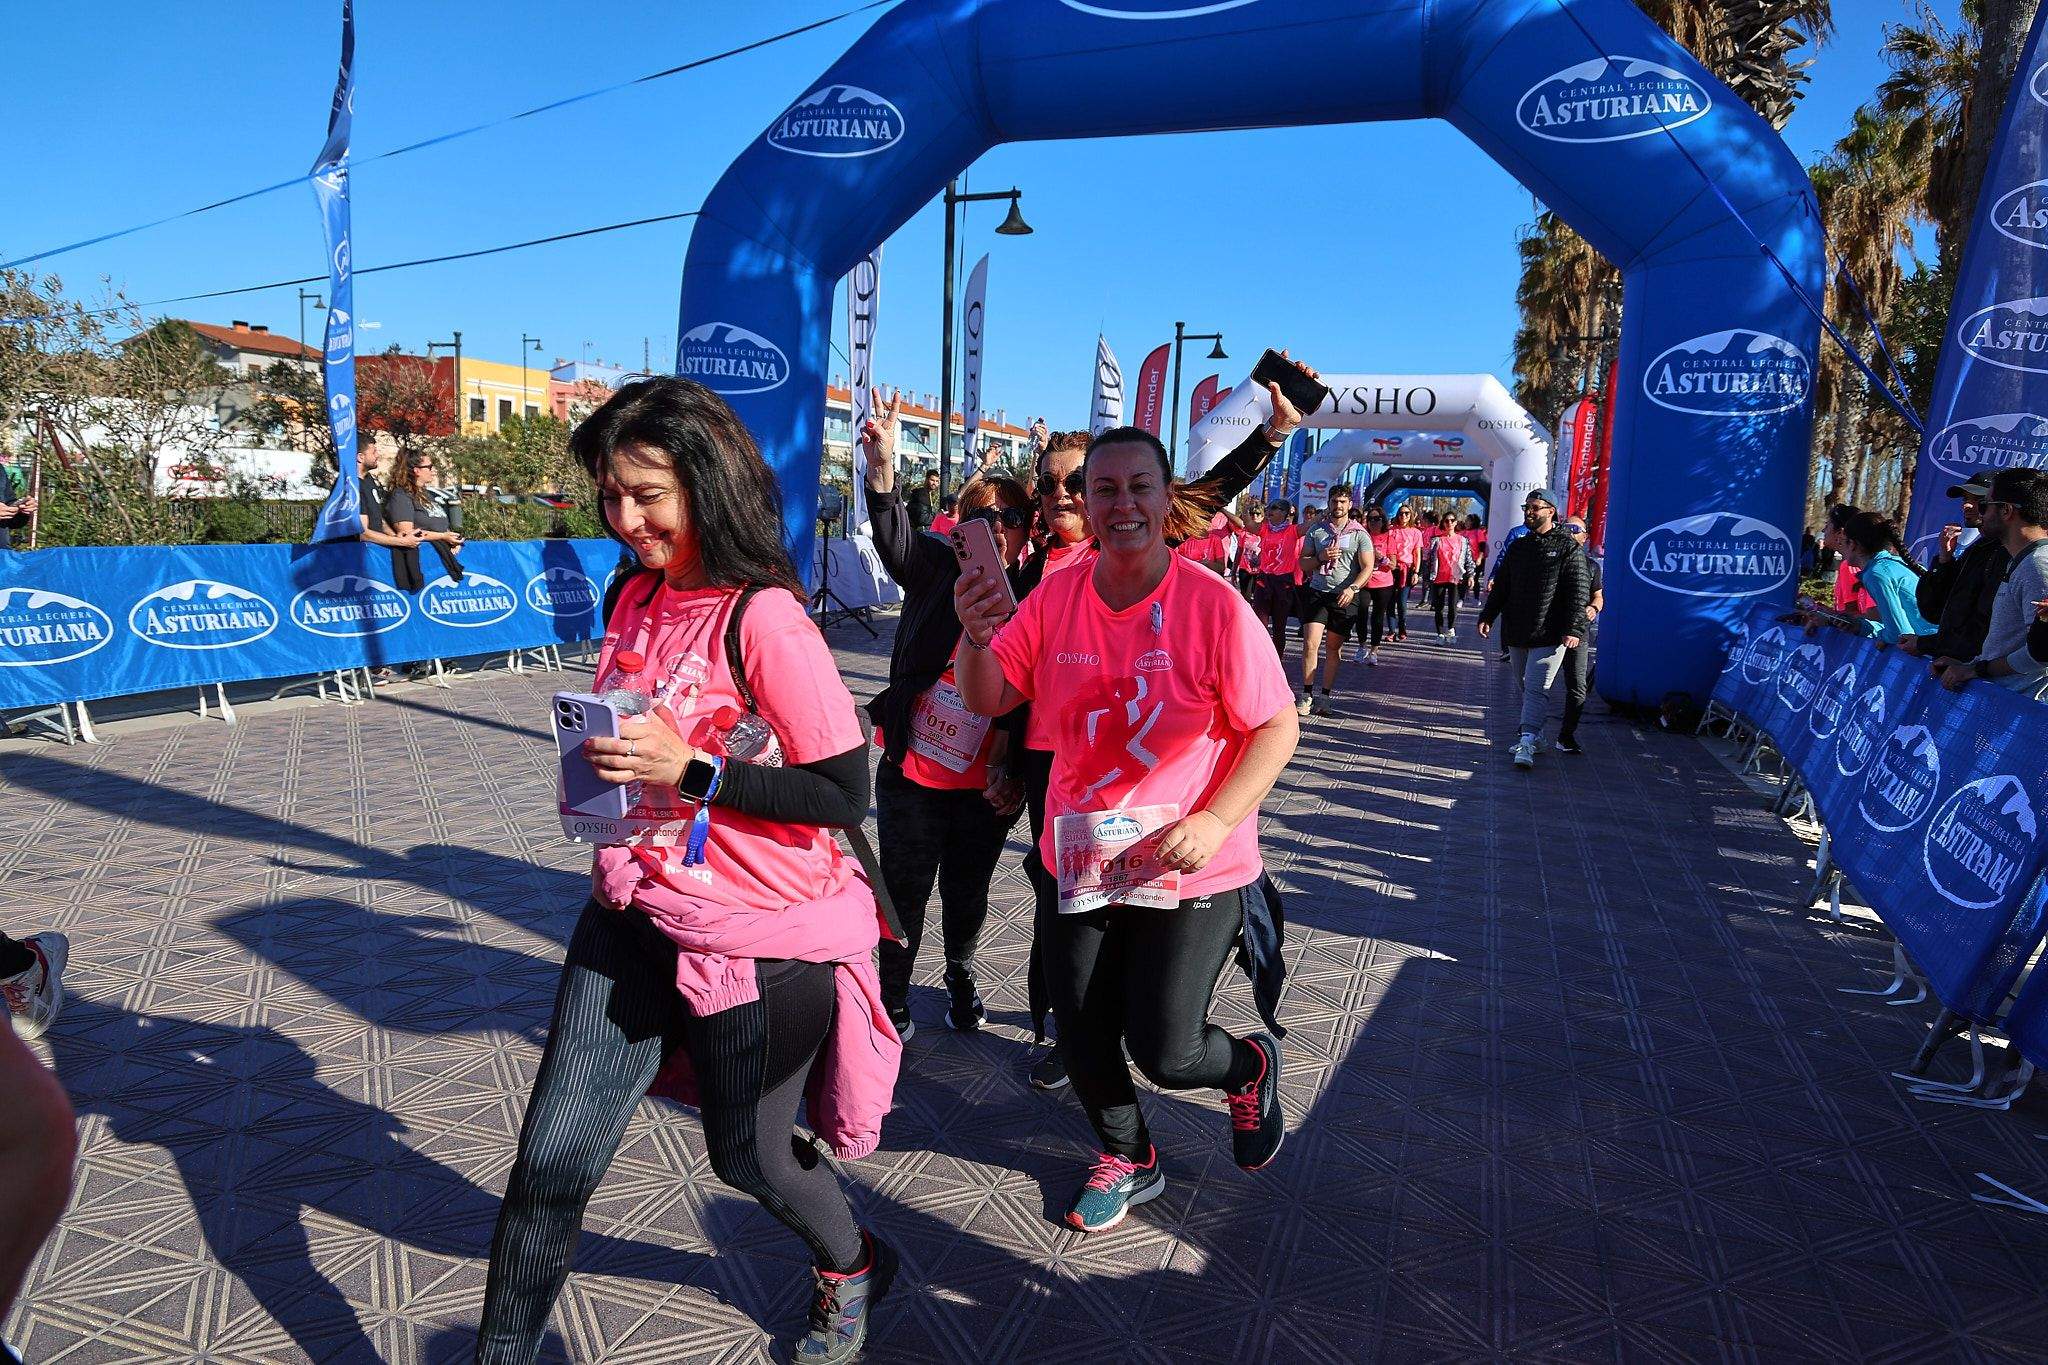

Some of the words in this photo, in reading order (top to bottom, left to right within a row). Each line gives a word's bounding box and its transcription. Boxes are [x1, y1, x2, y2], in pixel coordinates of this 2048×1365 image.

[1559, 83, 1623, 98] CENTRAL
[1630, 81, 1690, 93] LECHERA
[796, 108, 836, 118] CENTRAL
[840, 108, 888, 116] LECHERA
[1531, 93, 1699, 127] ASTURIANA
[773, 116, 893, 140] ASTURIANA
[1968, 318, 2048, 352] ASTU
[687, 346, 724, 354] CENTRAL
[727, 347, 775, 360] LECHERA
[677, 348, 779, 381] ASTURIANA
[1683, 359, 1744, 368] CENTRAL
[1653, 363, 1803, 395] ASTURIANA
[1144, 368, 1160, 432] ntander
[1328, 386, 1437, 416] YSHO
[1210, 415, 1251, 427] OYSHO
[1478, 420, 1524, 430] OYSHO
[1971, 434, 2026, 448] CENTRAL
[1403, 474, 1469, 483] VOLVO
[1668, 540, 1729, 550] CENTRAL
[1735, 541, 1785, 551] LECHERA
[1639, 541, 1786, 576] ASTURIANA
[162, 604, 212, 613] CENTRAL
[430, 593, 512, 615] ASTURIANA
[36, 611, 92, 621] LECHERA
[303, 600, 404, 625] ASTURIANA
[145, 607, 272, 636] ASTURIANA
[1056, 652, 1100, 666] OYSHO
[926, 714, 958, 737] 016
[762, 748, 780, 767] ERO
[574, 821, 617, 835] OYSHO
[642, 828, 686, 837] Santander
[1096, 825, 1140, 838] ASTURIANA
[1099, 854, 1143, 874] 016
[1129, 891, 1166, 902] Santander
